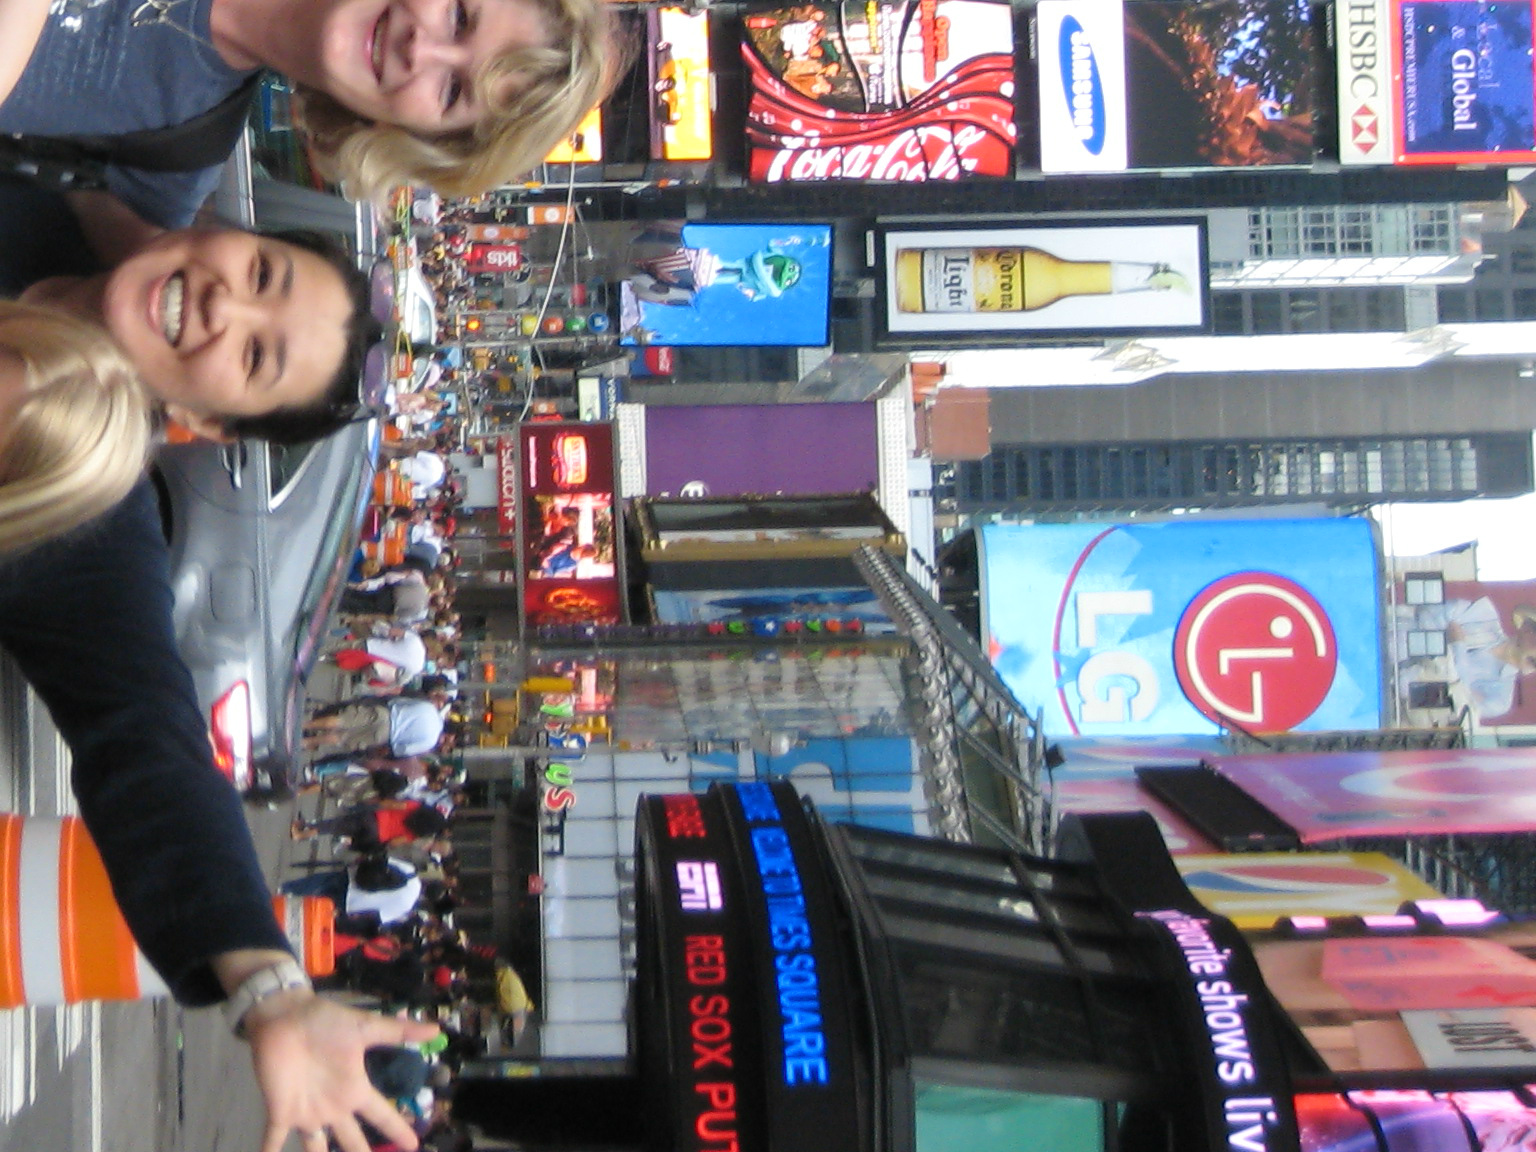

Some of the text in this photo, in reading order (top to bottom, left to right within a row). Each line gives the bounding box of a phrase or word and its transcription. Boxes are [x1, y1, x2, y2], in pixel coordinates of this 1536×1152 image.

[1070, 31, 1094, 140] SAMSUNG
[1348, 1, 1379, 98] HSBC
[1450, 25, 1477, 131] & Global
[486, 250, 519, 267] tkts
[943, 256, 971, 306] Light
[1074, 589, 1159, 724] LG
[684, 934, 728, 985] RED
[766, 894, 812, 951] TIMES
[689, 994, 735, 1070] SOX
[774, 954, 829, 1086] SQUARE
[1196, 980, 1256, 1083] shows
